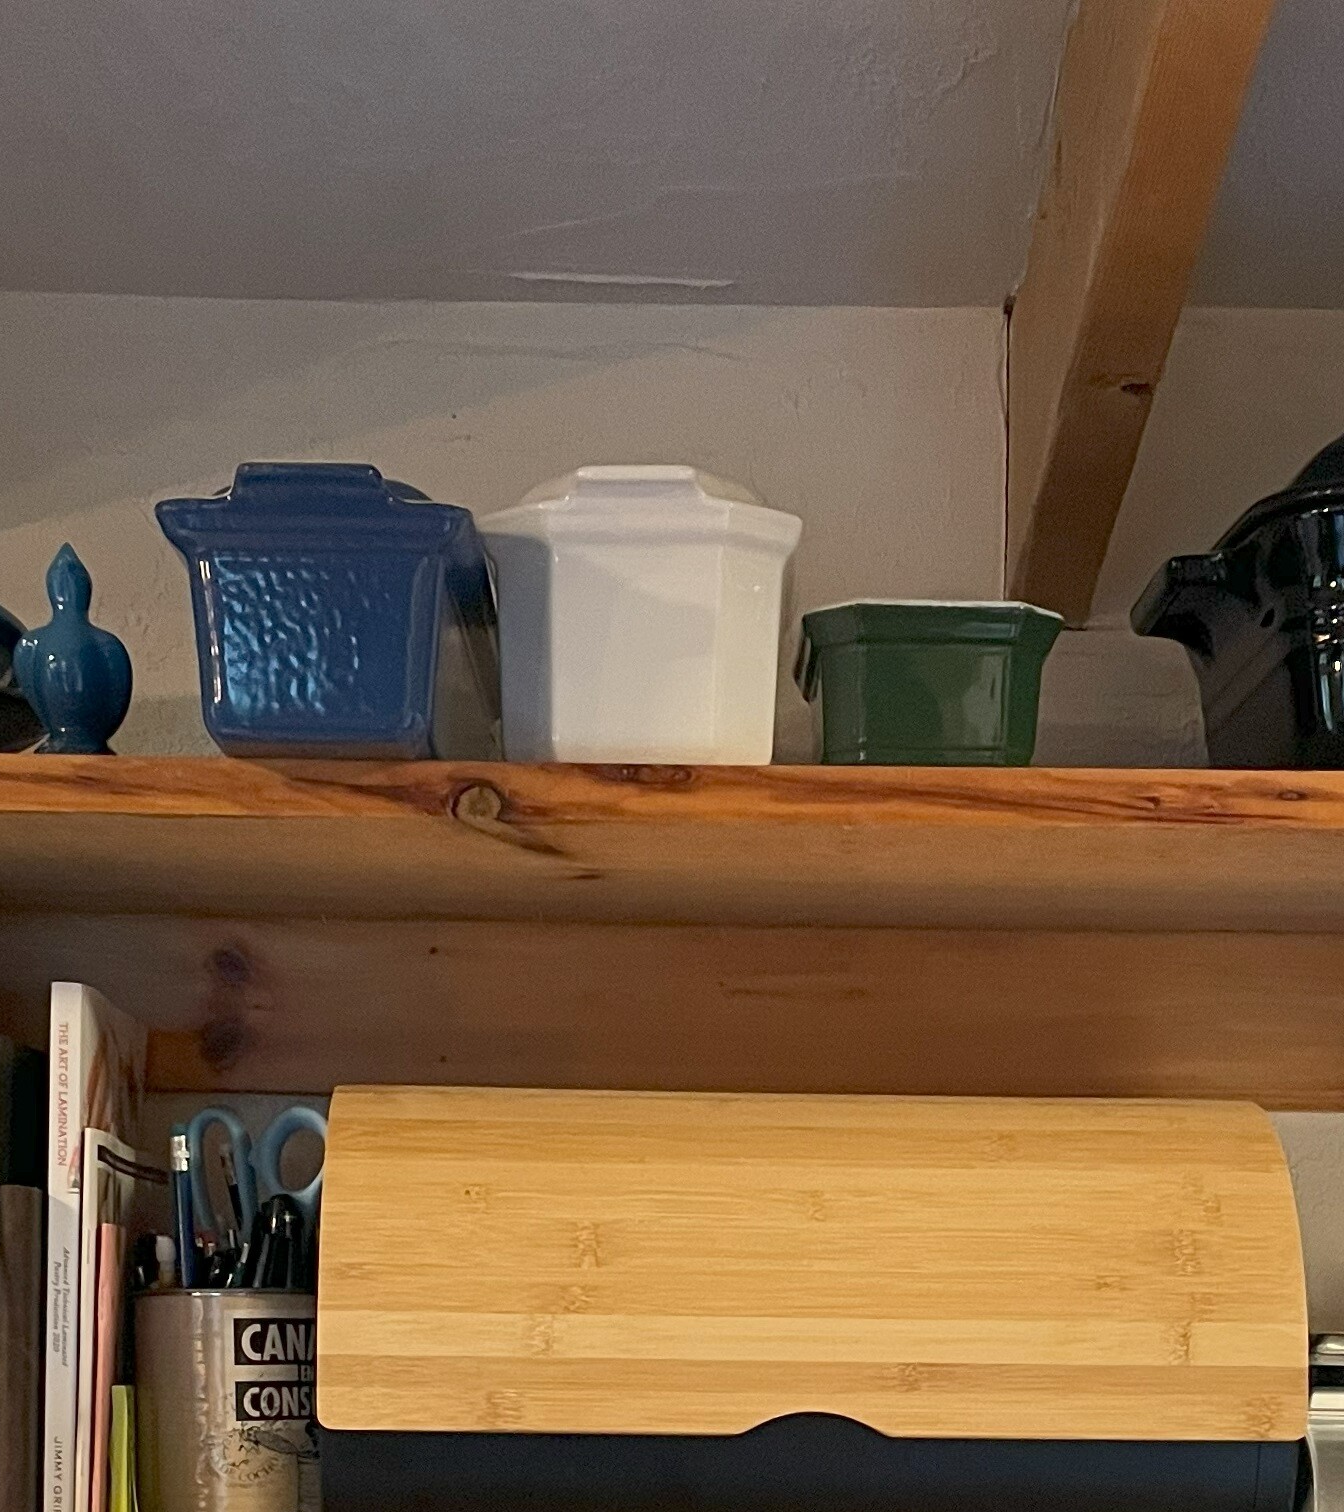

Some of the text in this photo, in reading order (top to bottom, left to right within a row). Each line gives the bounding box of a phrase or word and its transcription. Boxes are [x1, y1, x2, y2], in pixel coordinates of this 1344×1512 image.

[57, 1022, 68, 1166] THE ART OF LAMINATION
[242, 1386, 315, 1417] CONS
[54, 1436, 63, 1481] JIMMY
